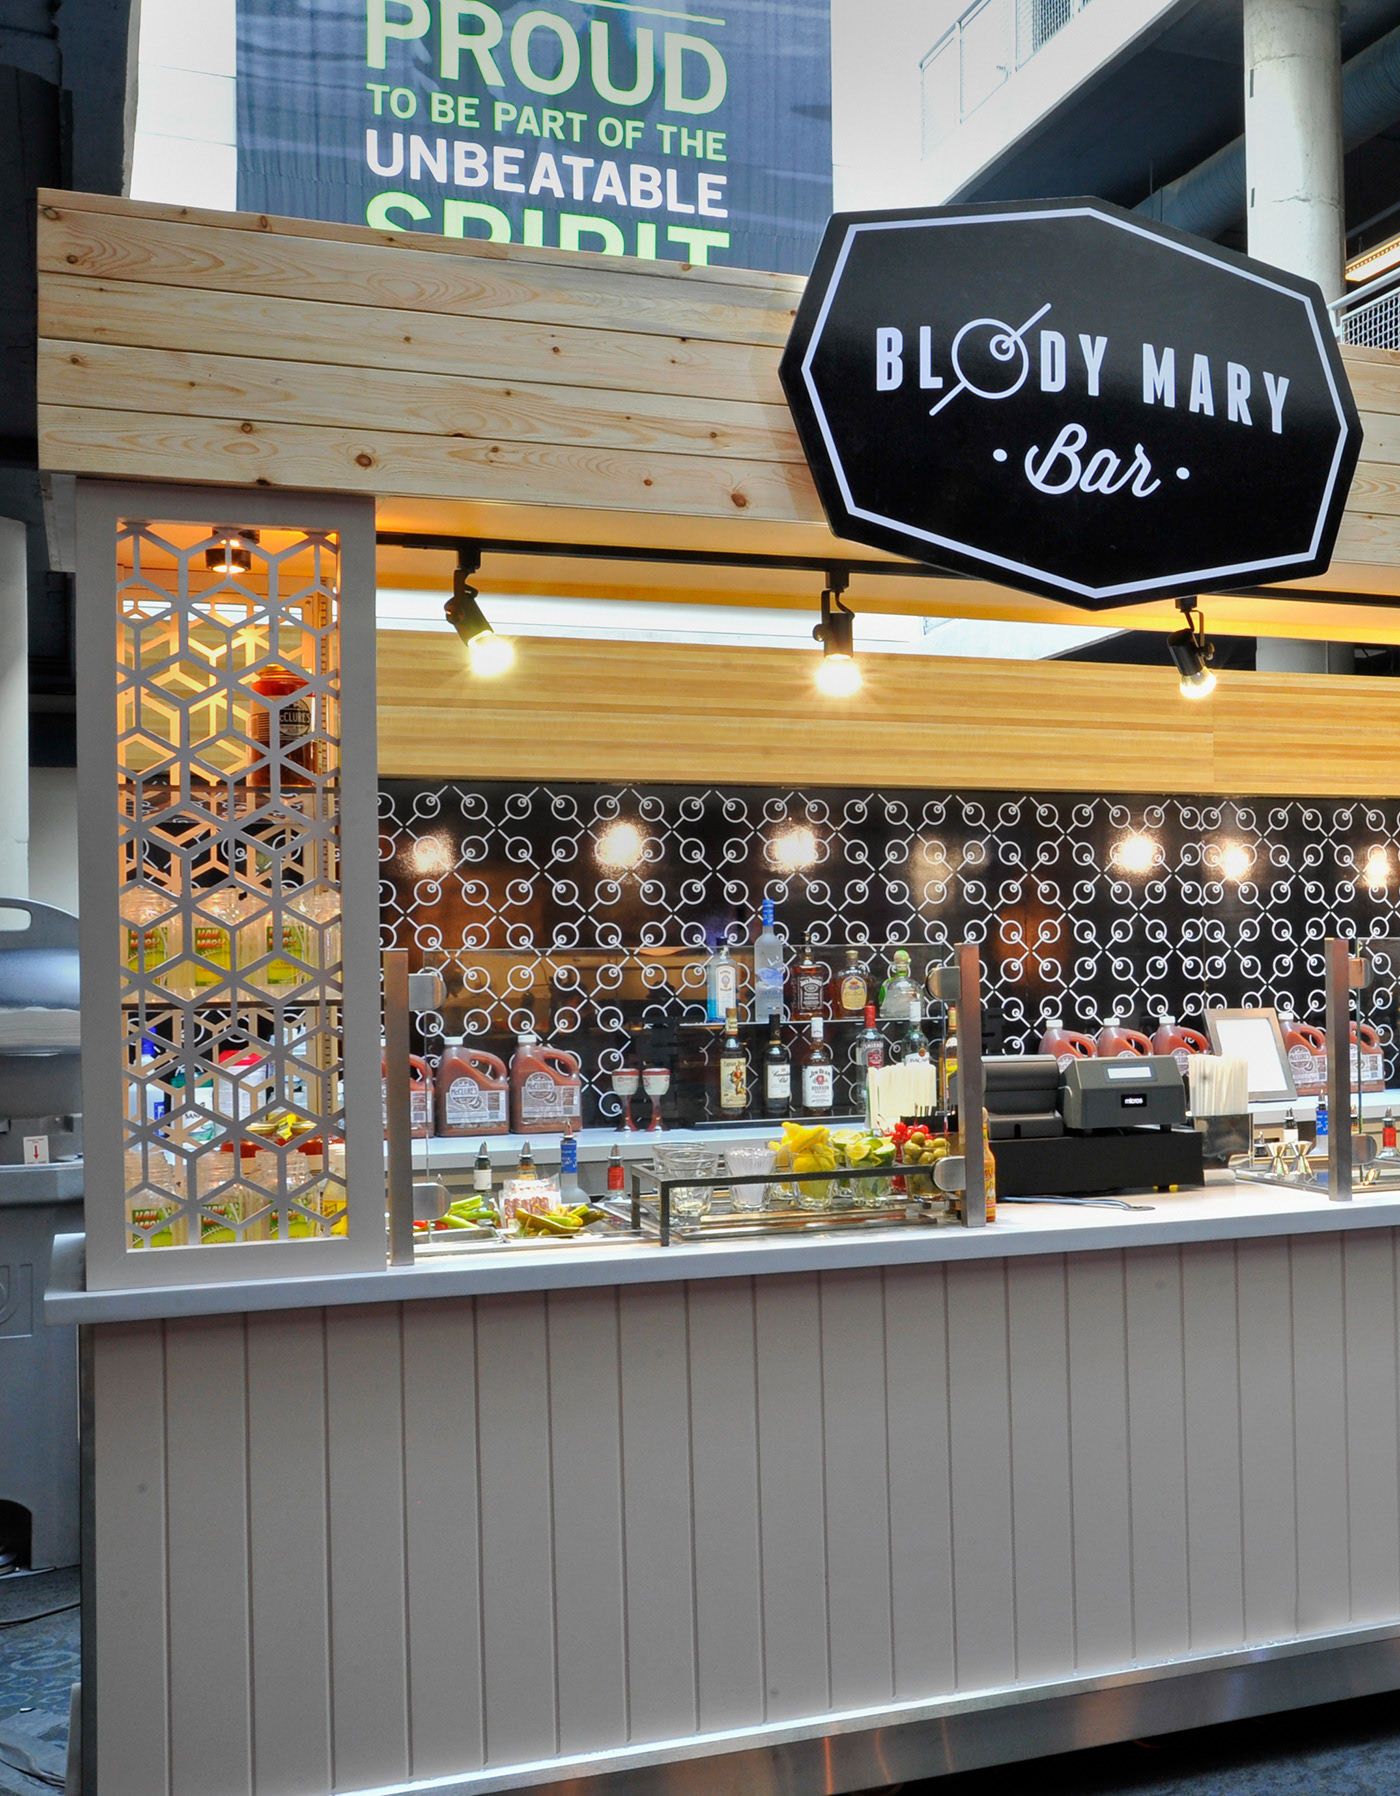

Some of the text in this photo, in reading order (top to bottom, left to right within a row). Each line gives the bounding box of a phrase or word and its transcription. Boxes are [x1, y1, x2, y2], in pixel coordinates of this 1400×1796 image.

[366, 0, 728, 115] PROUD
[366, 83, 727, 162] TO BE PART OF THE
[366, 128, 728, 219] UNBEATABLE
[876, 310, 1290, 434] BLOODY MARY
[1024, 422, 1162, 497] Bar
